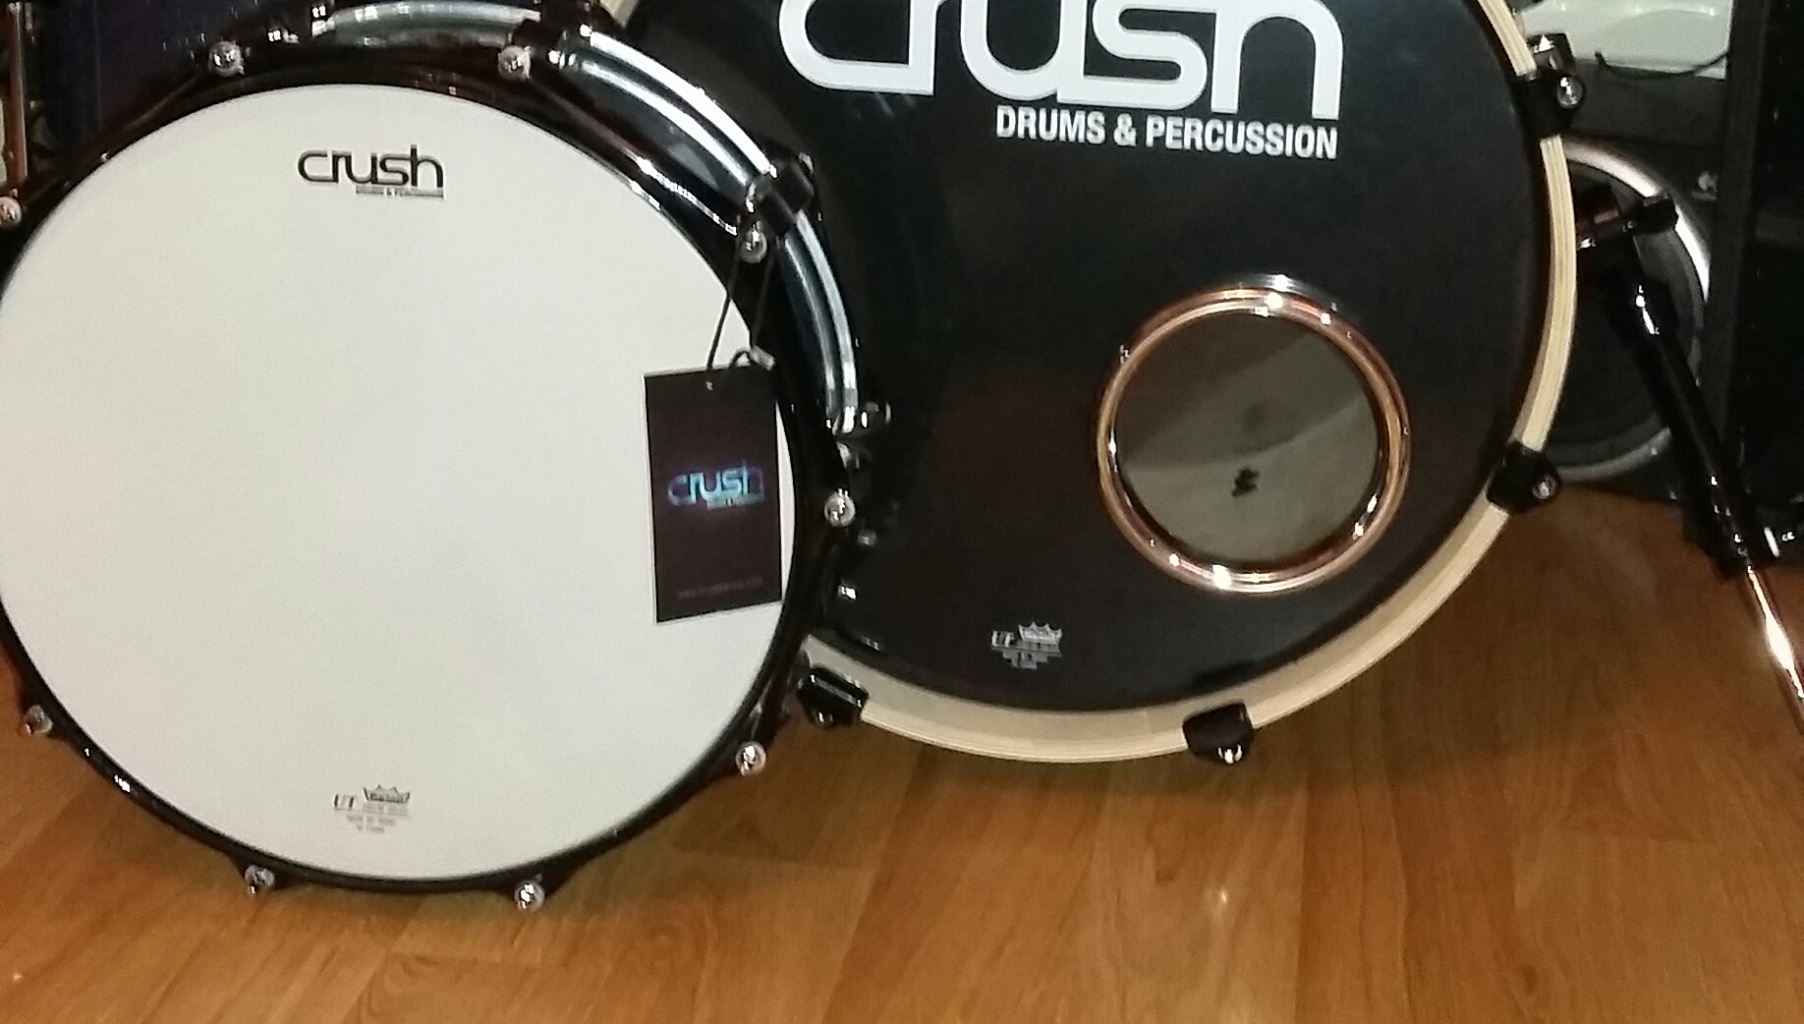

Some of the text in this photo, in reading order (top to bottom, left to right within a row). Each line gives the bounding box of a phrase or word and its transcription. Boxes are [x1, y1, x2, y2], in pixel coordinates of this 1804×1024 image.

[997, 105, 1337, 160] DRUMS & PERCUSSION
[298, 144, 443, 188] crush
[667, 460, 764, 506] crush
